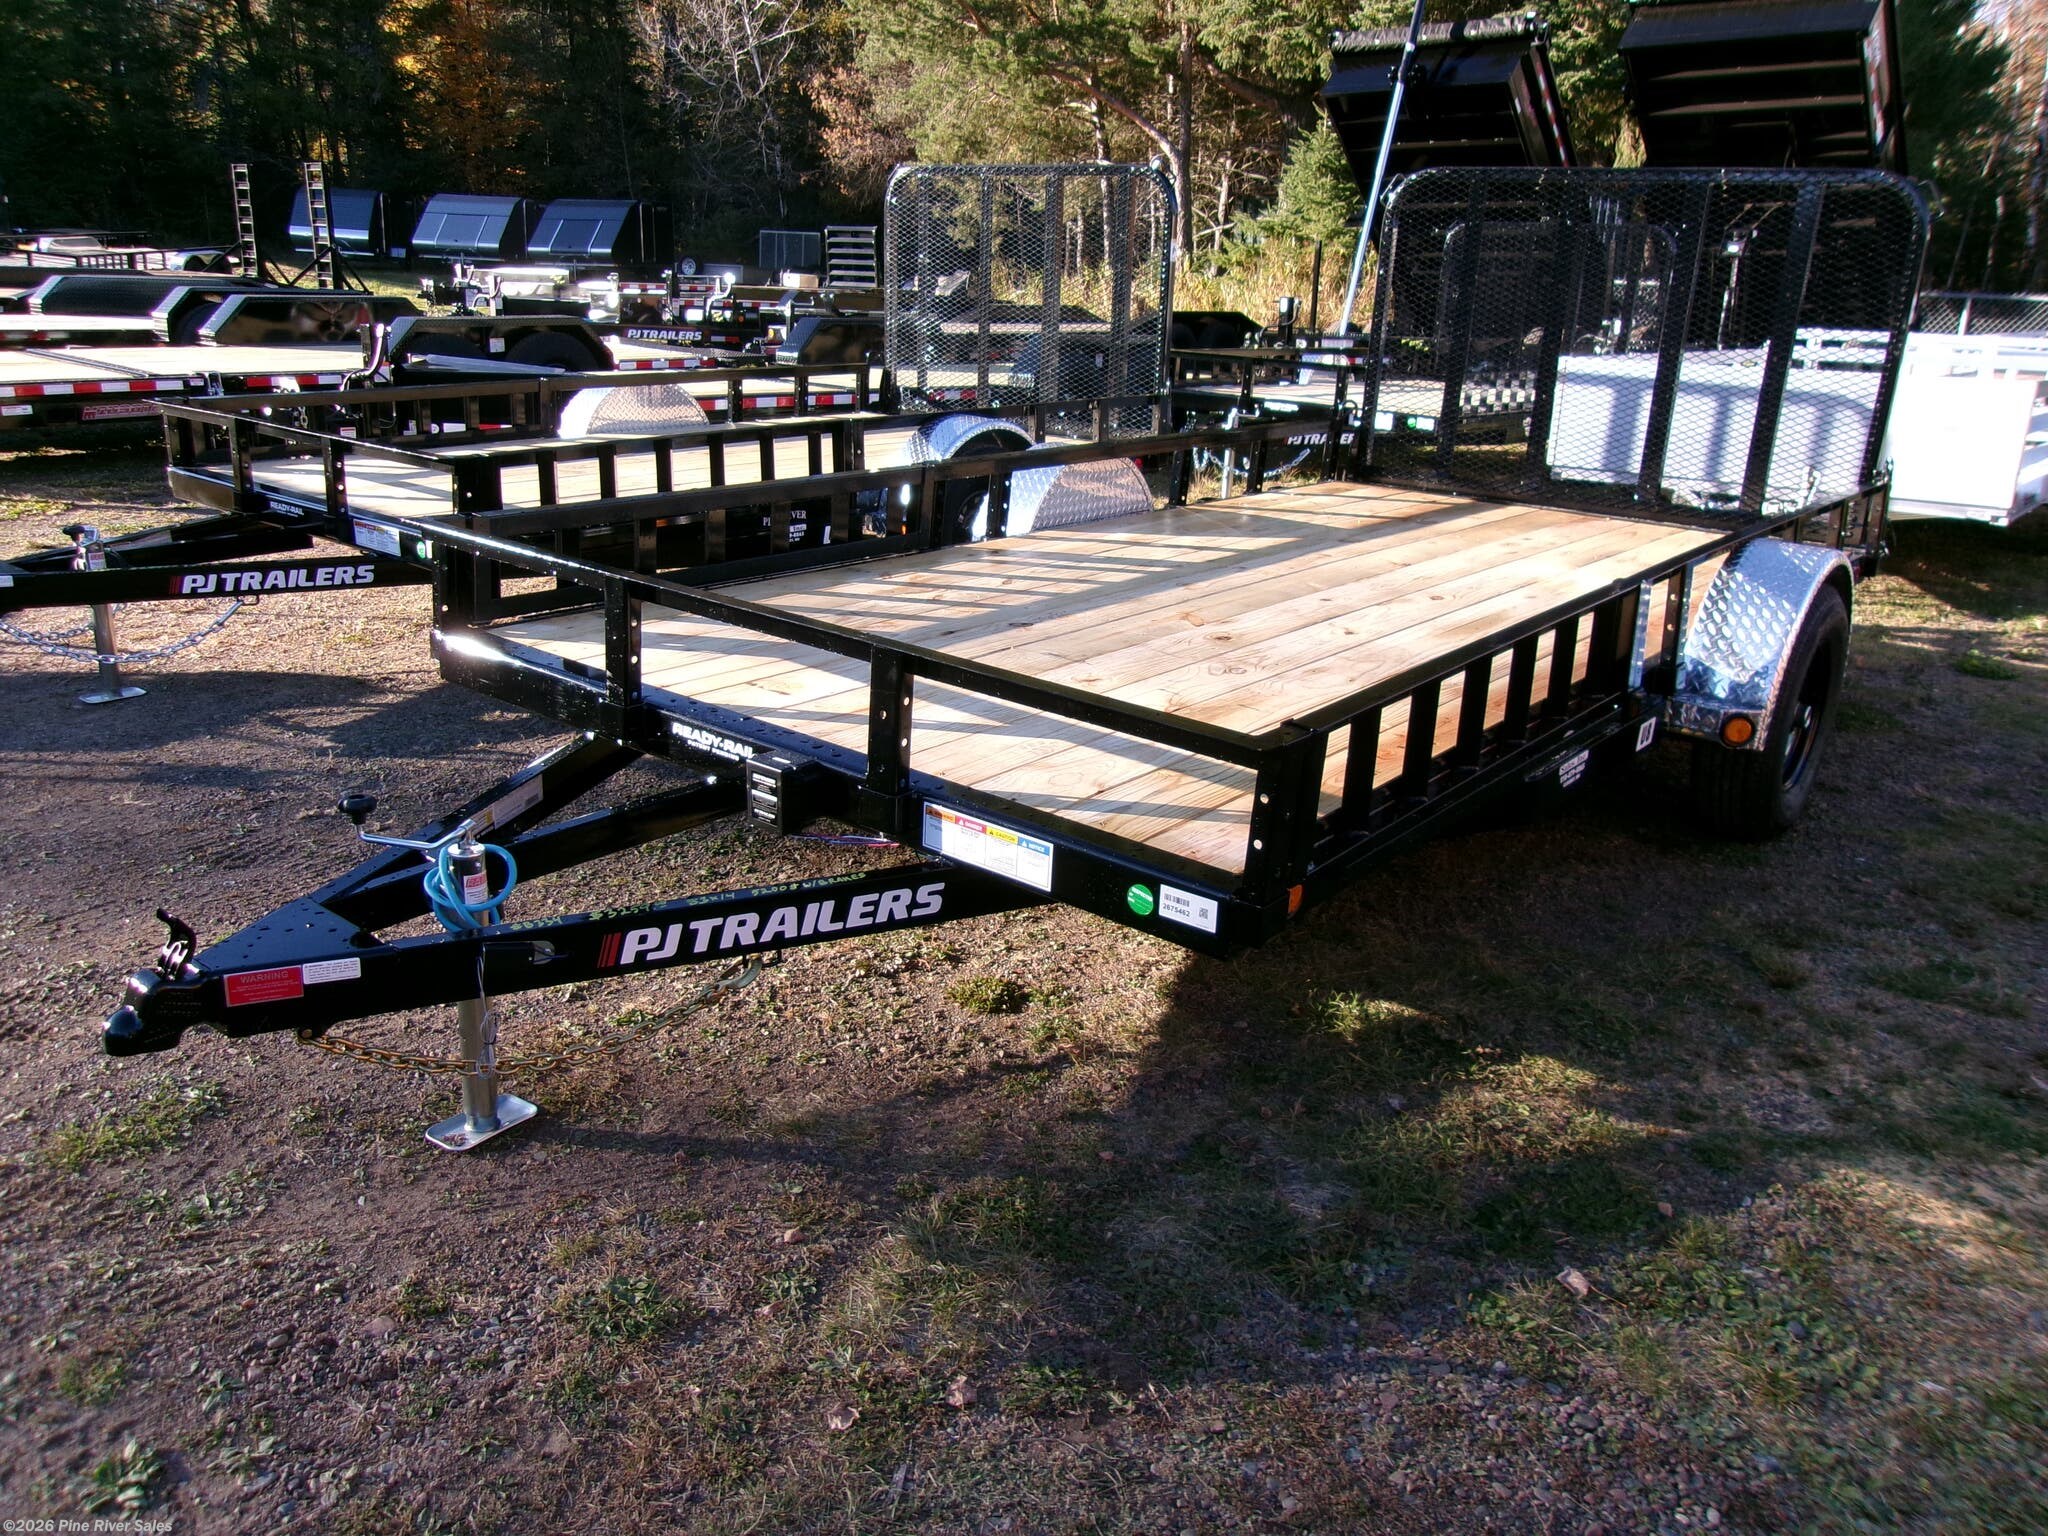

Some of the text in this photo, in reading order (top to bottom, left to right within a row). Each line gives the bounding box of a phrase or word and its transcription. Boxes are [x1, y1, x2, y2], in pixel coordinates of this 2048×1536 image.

[642, 330, 702, 341] TRAILERS
[1304, 433, 1355, 445] TRAER
[182, 565, 375, 594] PJ TRAILERS
[1162, 903, 1191, 918] 2675462
[619, 882, 945, 966] PJ TRAILERS
[240, 971, 289, 984] WARNING
